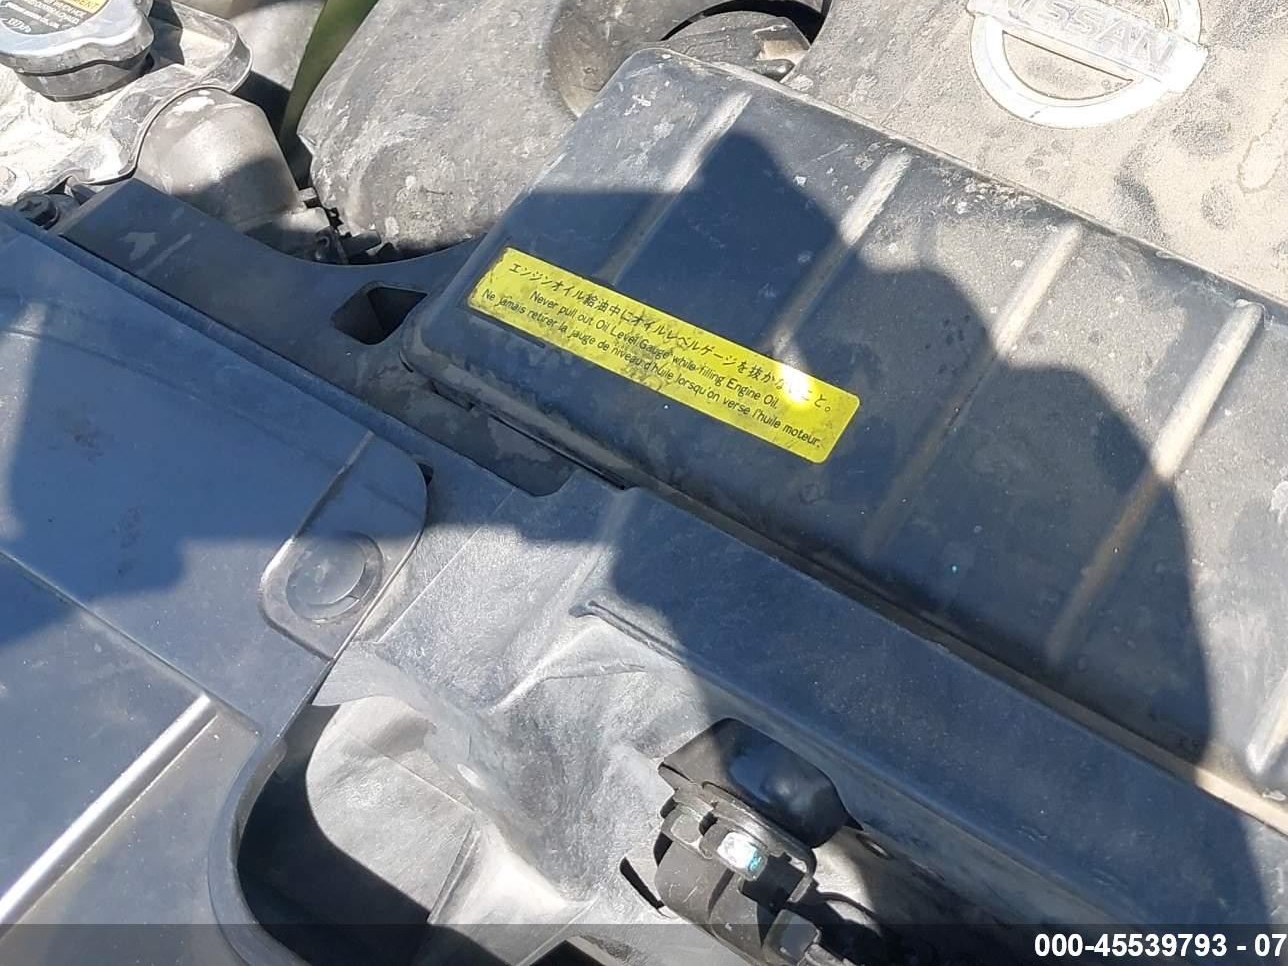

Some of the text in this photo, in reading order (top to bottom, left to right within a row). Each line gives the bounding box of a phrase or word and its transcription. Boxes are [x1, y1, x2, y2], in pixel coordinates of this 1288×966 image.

[484, 289, 497, 301] Ne
[497, 295, 528, 316] jamais
[528, 309, 559, 328] retirer
[559, 322, 569, 333] la
[569, 328, 596, 347] jauge
[597, 339, 611, 351] de
[611, 346, 646, 367] niveau
[675, 374, 722, 404] lorsqu'on
[723, 398, 751, 415] verse
[753, 409, 783, 429] l'huile
[783, 424, 823, 448] moteur.
[509, 262, 832, 411] エンジンオイル給油中にオイルレベルゲージを抜かなこと。
[530, 291, 560, 310] Never
[558, 303, 578, 320] pull
[579, 313, 595, 325] out
[595, 319, 611, 332] Oil
[610, 325, 640, 345] Level
[637, 338, 671, 362] Gauge
[672, 353, 698, 371] while
[698, 365, 726, 387] filling
[726, 378, 763, 403] Engine
